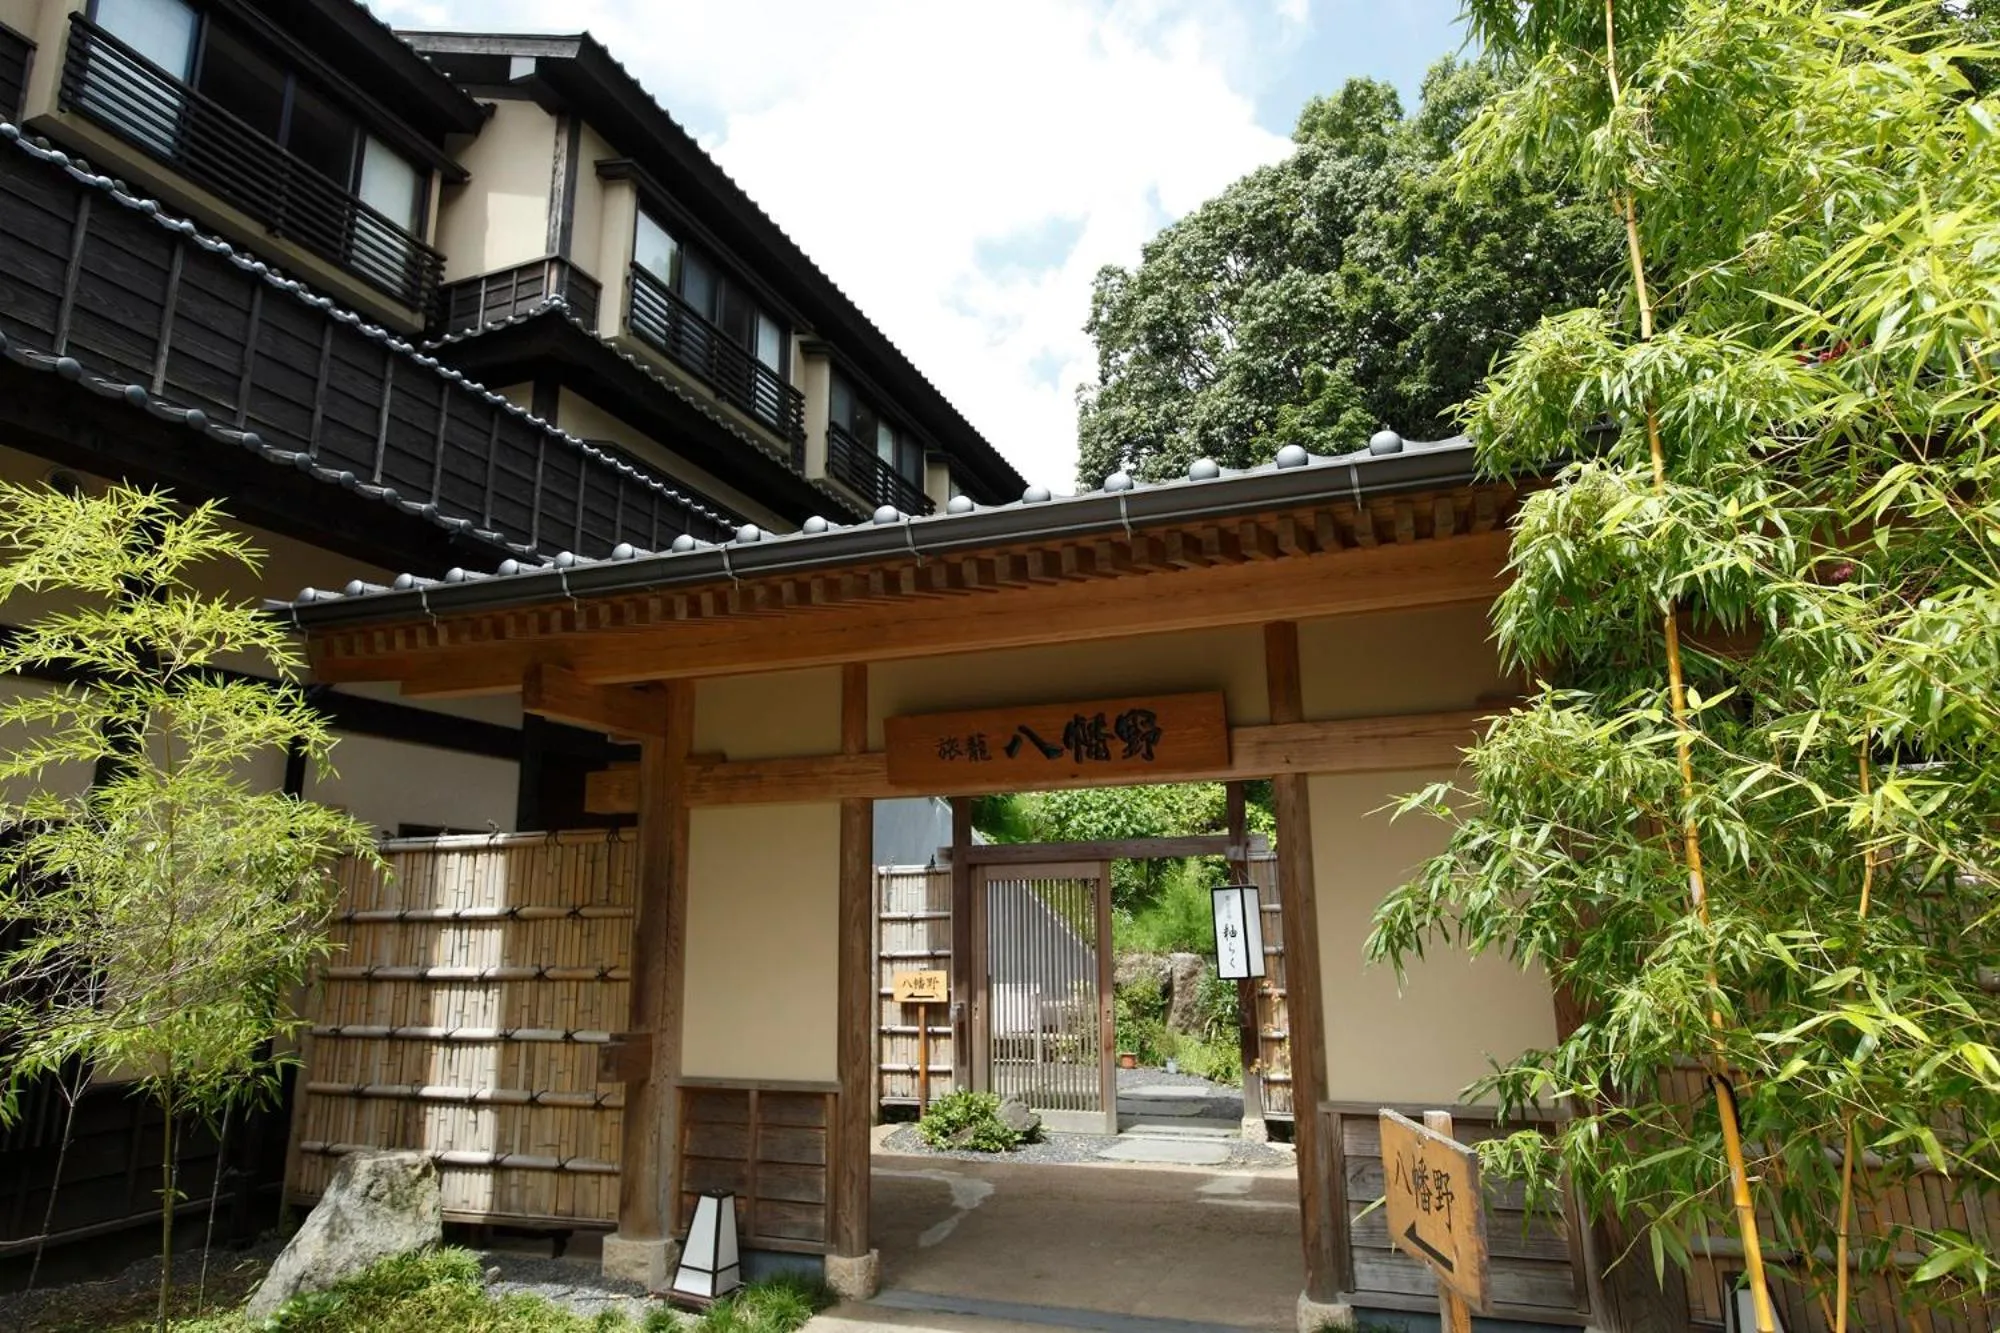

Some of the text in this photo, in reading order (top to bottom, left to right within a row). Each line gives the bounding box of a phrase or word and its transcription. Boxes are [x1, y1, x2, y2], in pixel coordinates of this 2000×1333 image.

[1003, 708, 1163, 764] 八幡野
[902, 976, 940, 990] 八幡野
[1395, 1151, 1455, 1234] 八幡野
